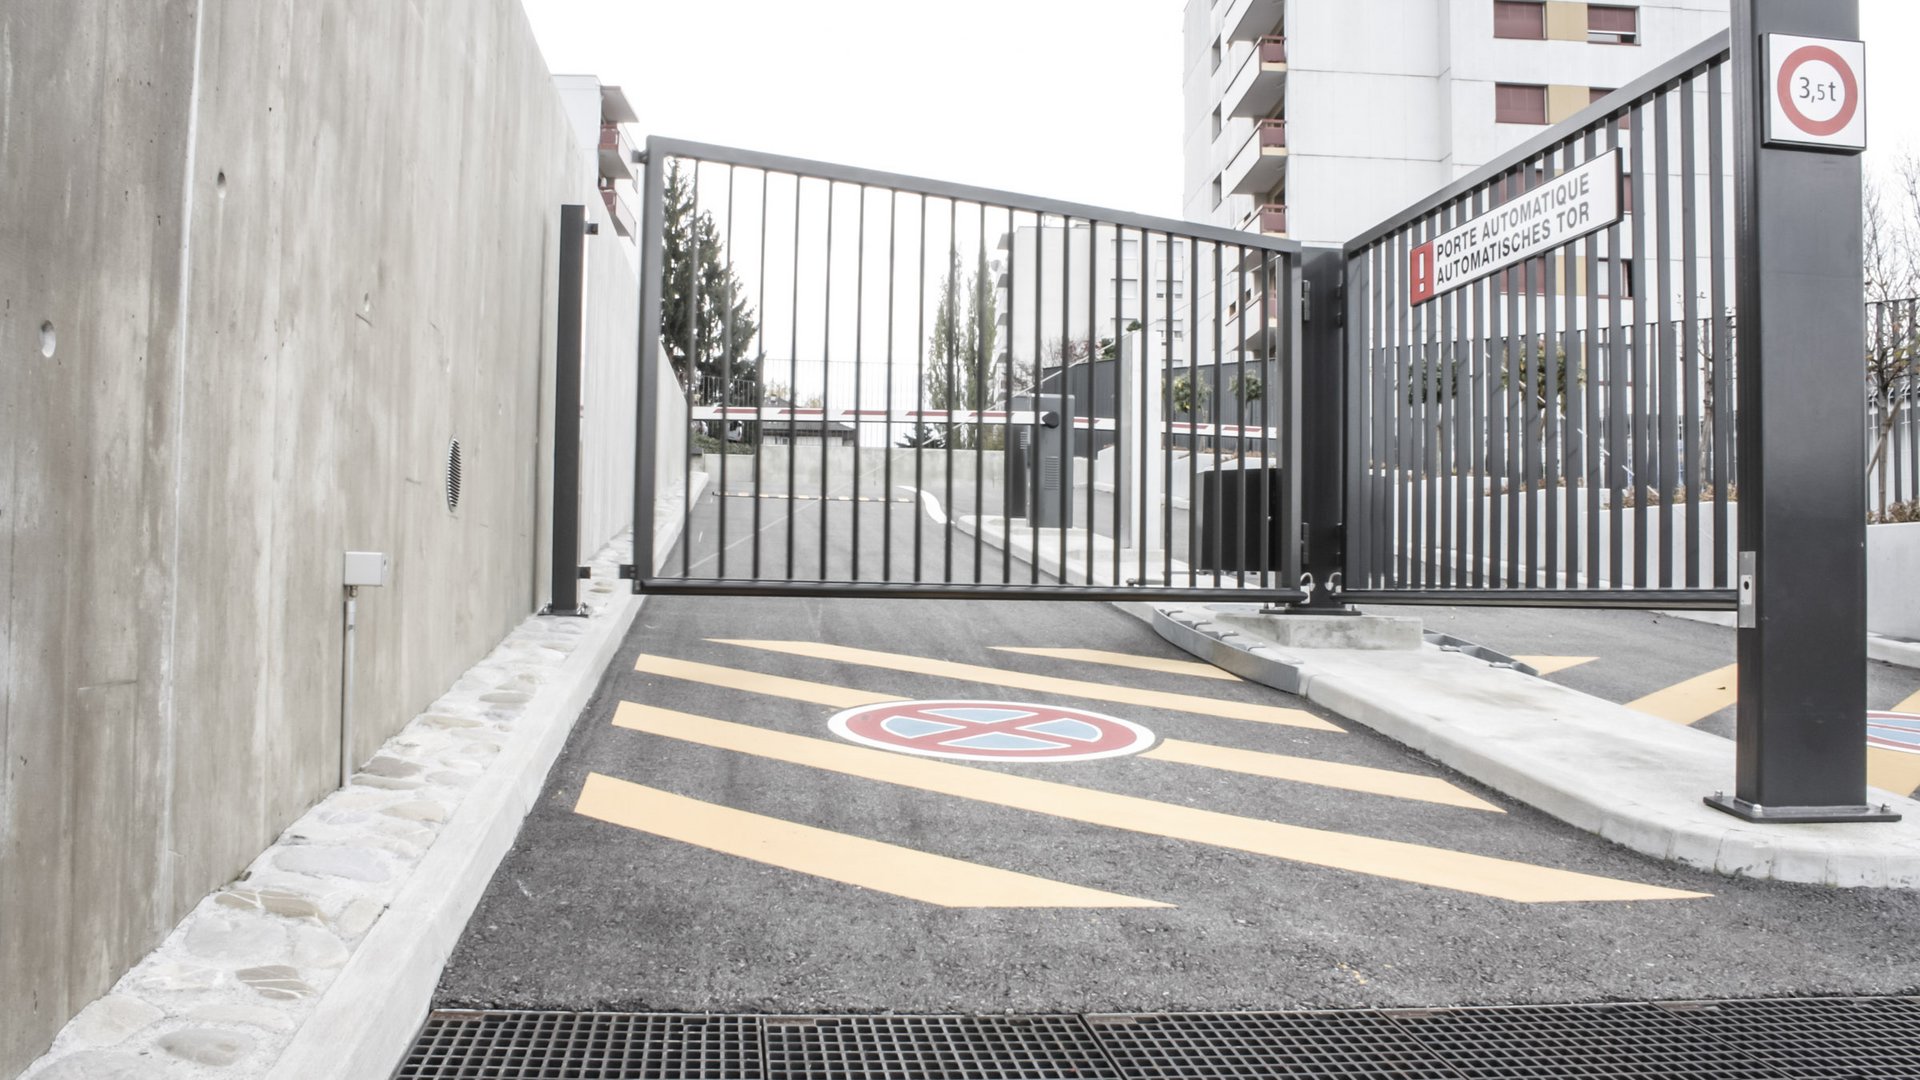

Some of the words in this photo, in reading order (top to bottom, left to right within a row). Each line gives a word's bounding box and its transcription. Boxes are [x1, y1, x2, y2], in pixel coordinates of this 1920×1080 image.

[1437, 227, 1477, 262] PORTE
[1483, 173, 1590, 241] AUTOMATIQUE
[1437, 219, 1551, 285] AUTOMATISCHES
[1557, 201, 1590, 233] TOR
